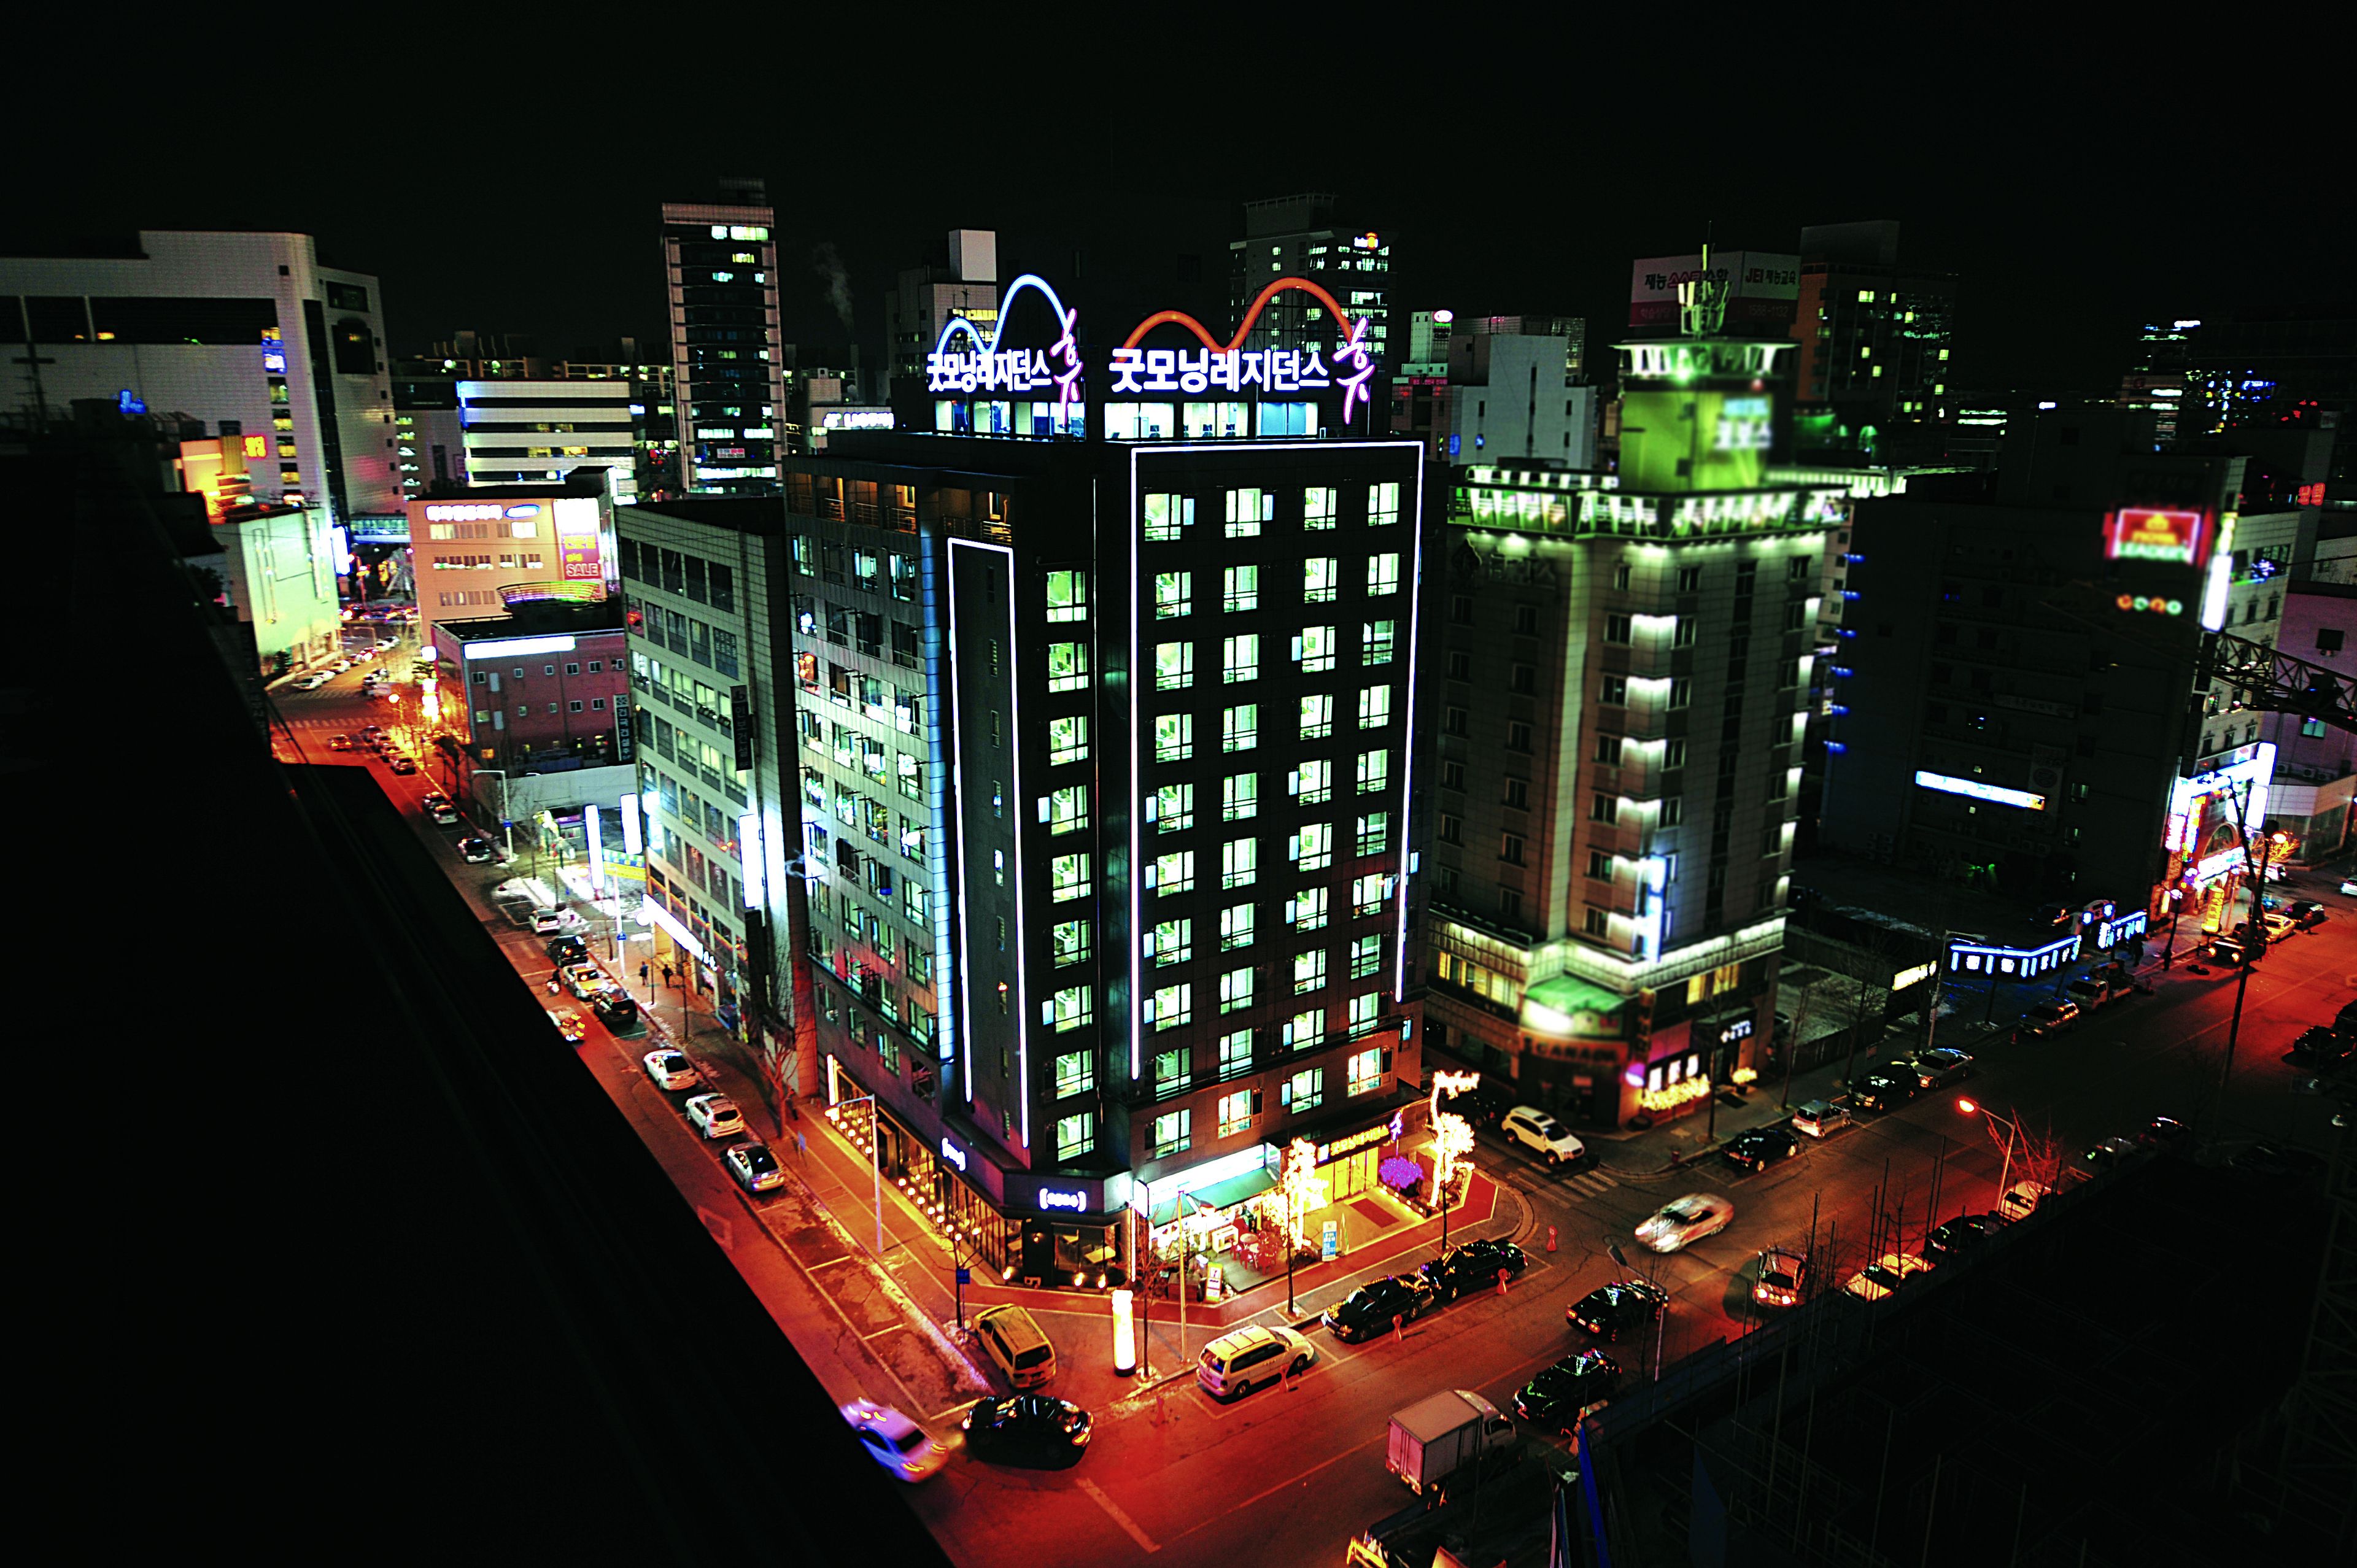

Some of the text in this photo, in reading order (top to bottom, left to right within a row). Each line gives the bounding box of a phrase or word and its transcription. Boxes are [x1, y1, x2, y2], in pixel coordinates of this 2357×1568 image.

[1745, 268, 1797, 285] JEI 재능교육
[926, 348, 1052, 393] 굿모닝레지던스
[1109, 347, 1330, 393] 굿모닝레지던스
[565, 563, 598, 577] SALE
